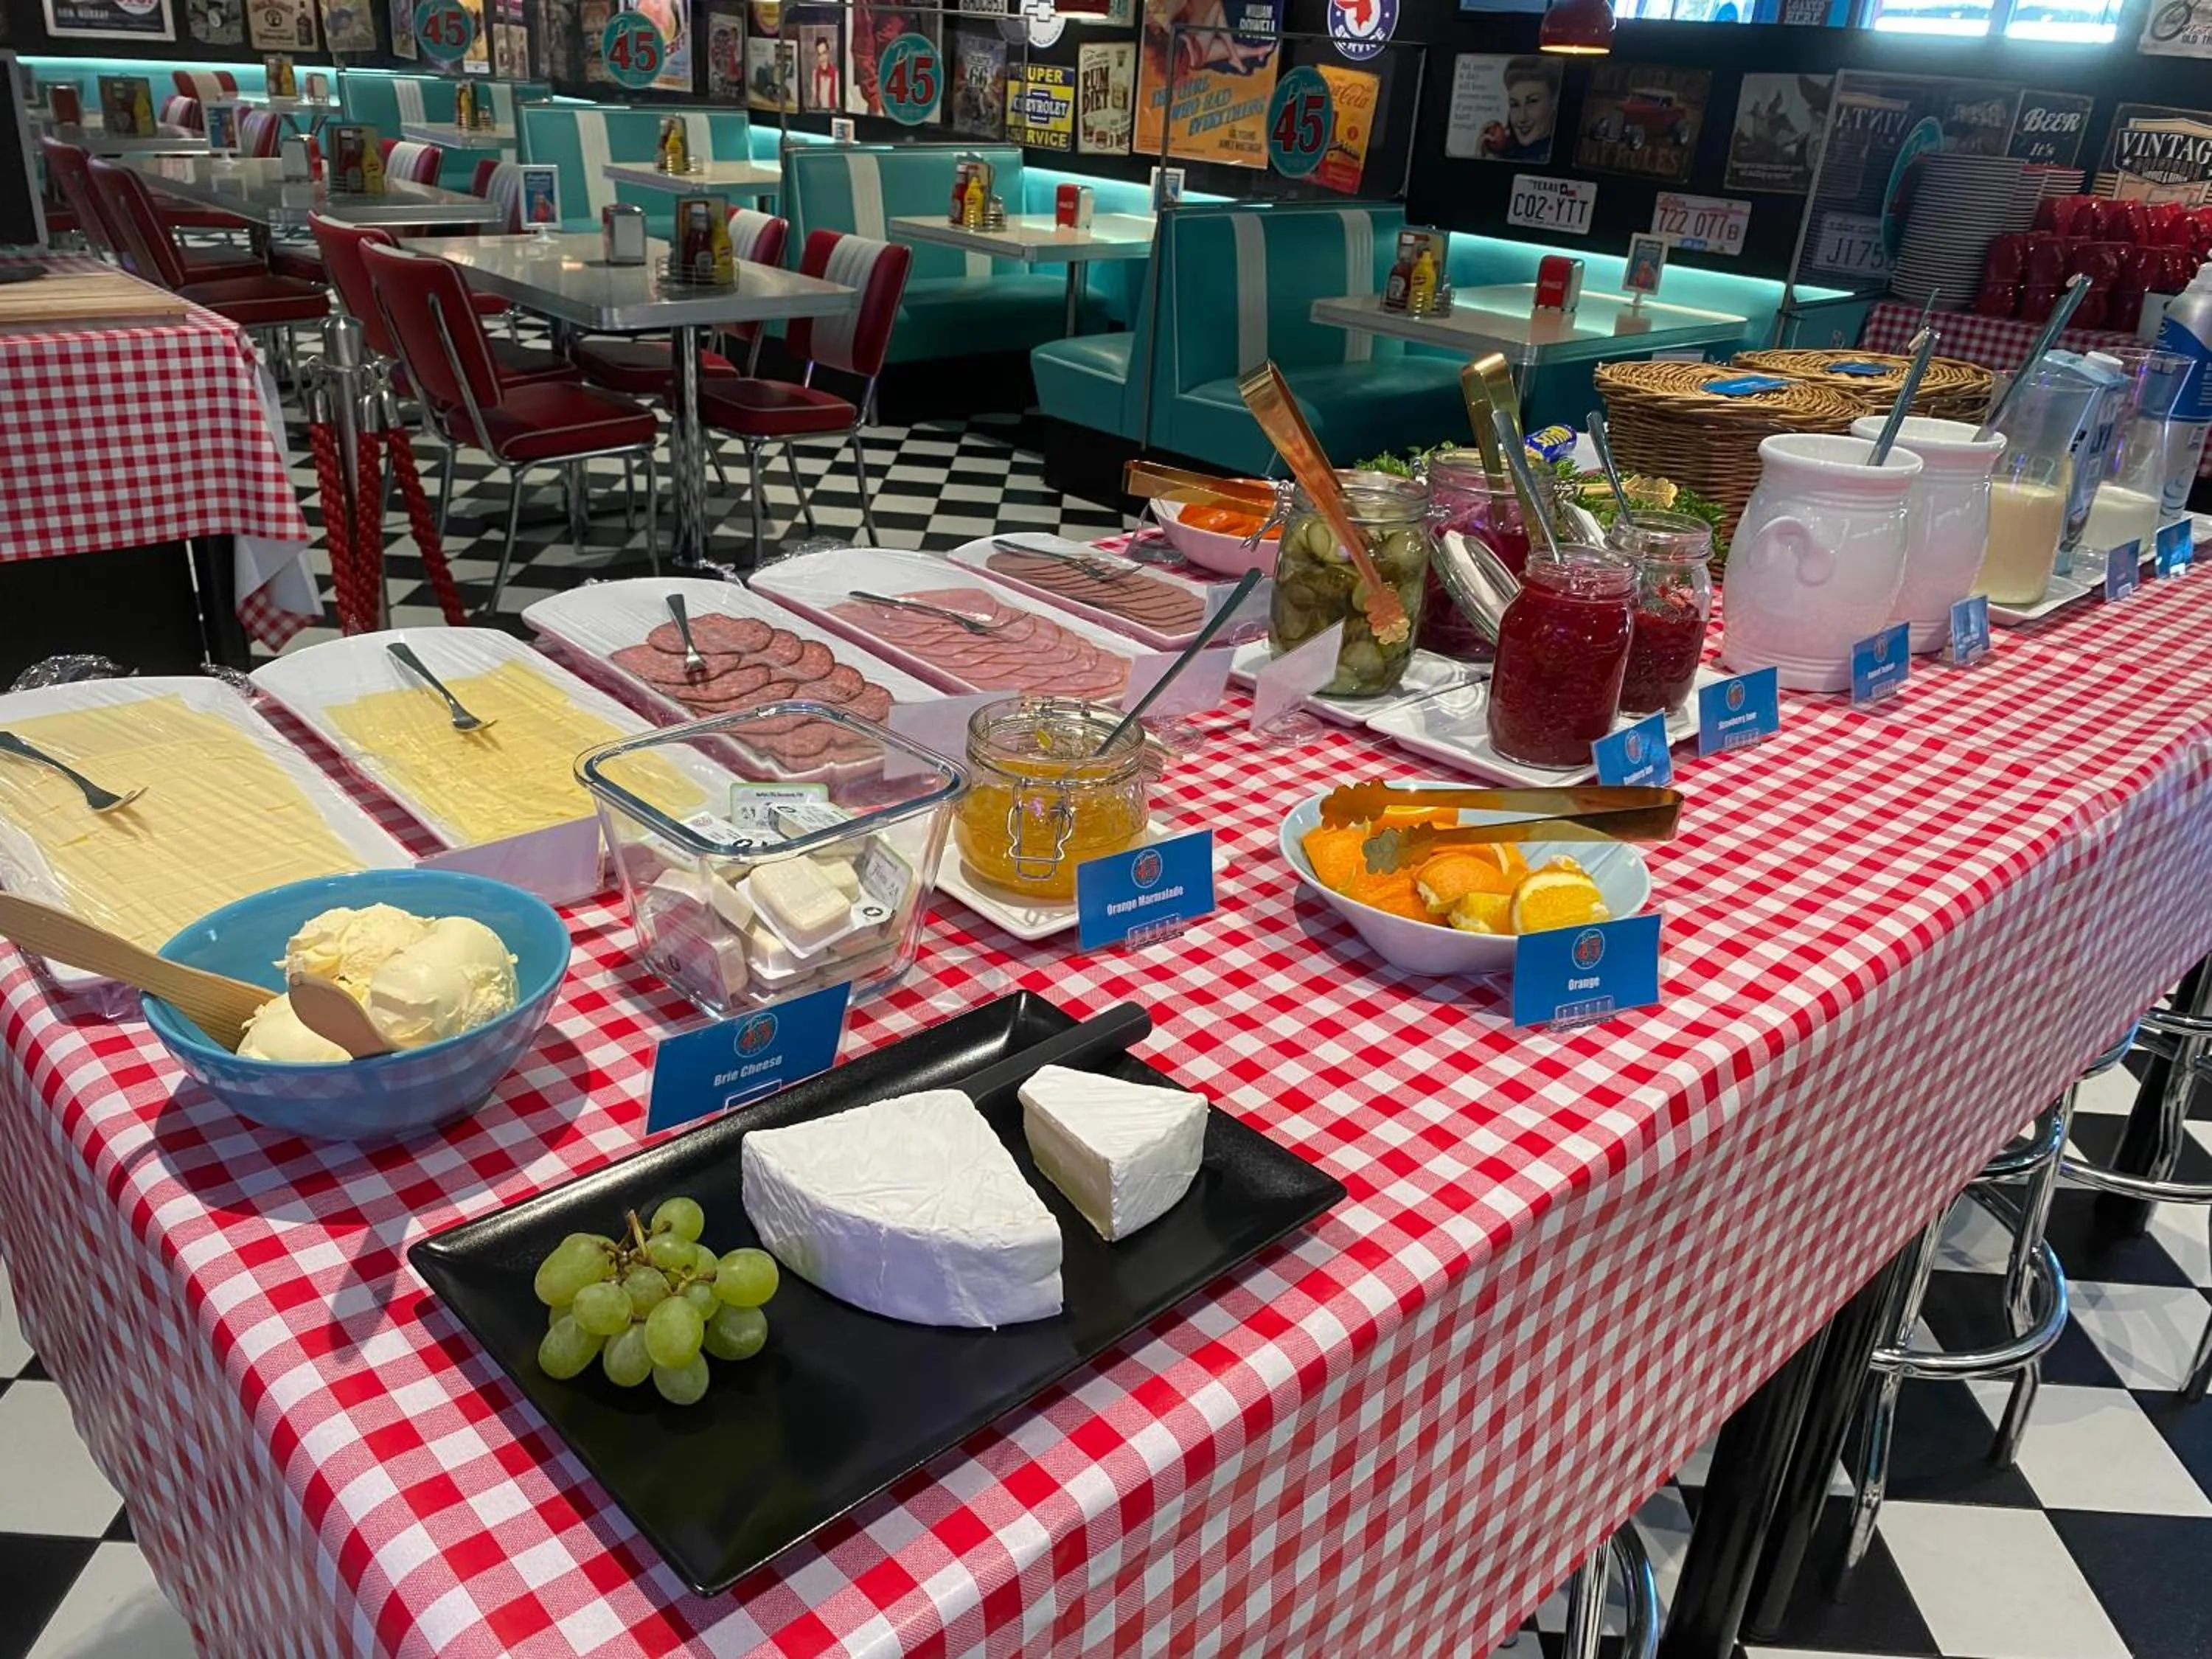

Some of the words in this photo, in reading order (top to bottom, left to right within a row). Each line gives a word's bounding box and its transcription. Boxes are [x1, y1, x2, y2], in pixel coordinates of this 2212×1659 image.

[423, 11, 466, 46] 45
[608, 32, 658, 72] 45
[886, 56, 934, 104] 45
[1015, 64, 1063, 85] UPER
[1272, 95, 1326, 153] 45
[1532, 181, 1558, 192] TEXAS
[1658, 207, 1688, 234] 722
[1107, 897, 1138, 917] Orange
[1138, 885, 1184, 908] Marmalade
[1568, 975, 1601, 992] Orange
[714, 1070, 739, 1087] Brie
[740, 1055, 782, 1077] Cheese
